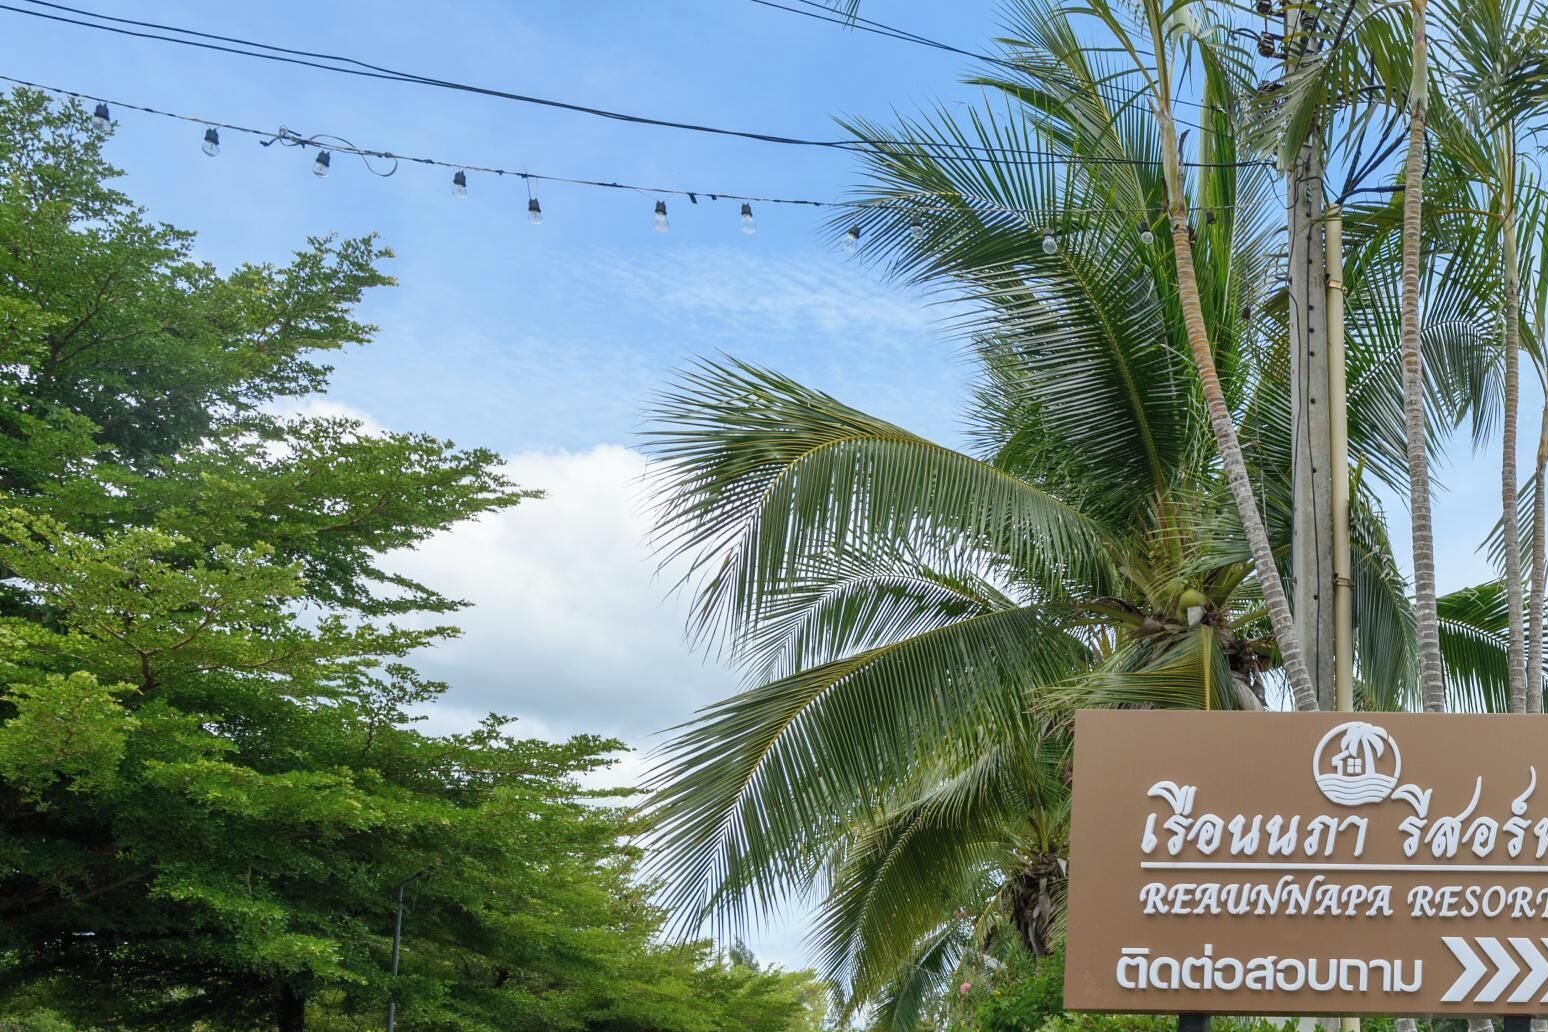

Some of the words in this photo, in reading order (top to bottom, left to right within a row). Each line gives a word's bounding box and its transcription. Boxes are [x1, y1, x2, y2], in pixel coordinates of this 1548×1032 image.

[1141, 780, 1369, 857] เรือนนภา
[1140, 875, 1394, 916] REAUNNAPA
[1116, 943, 1423, 993] ติดต่อสอบถาม
